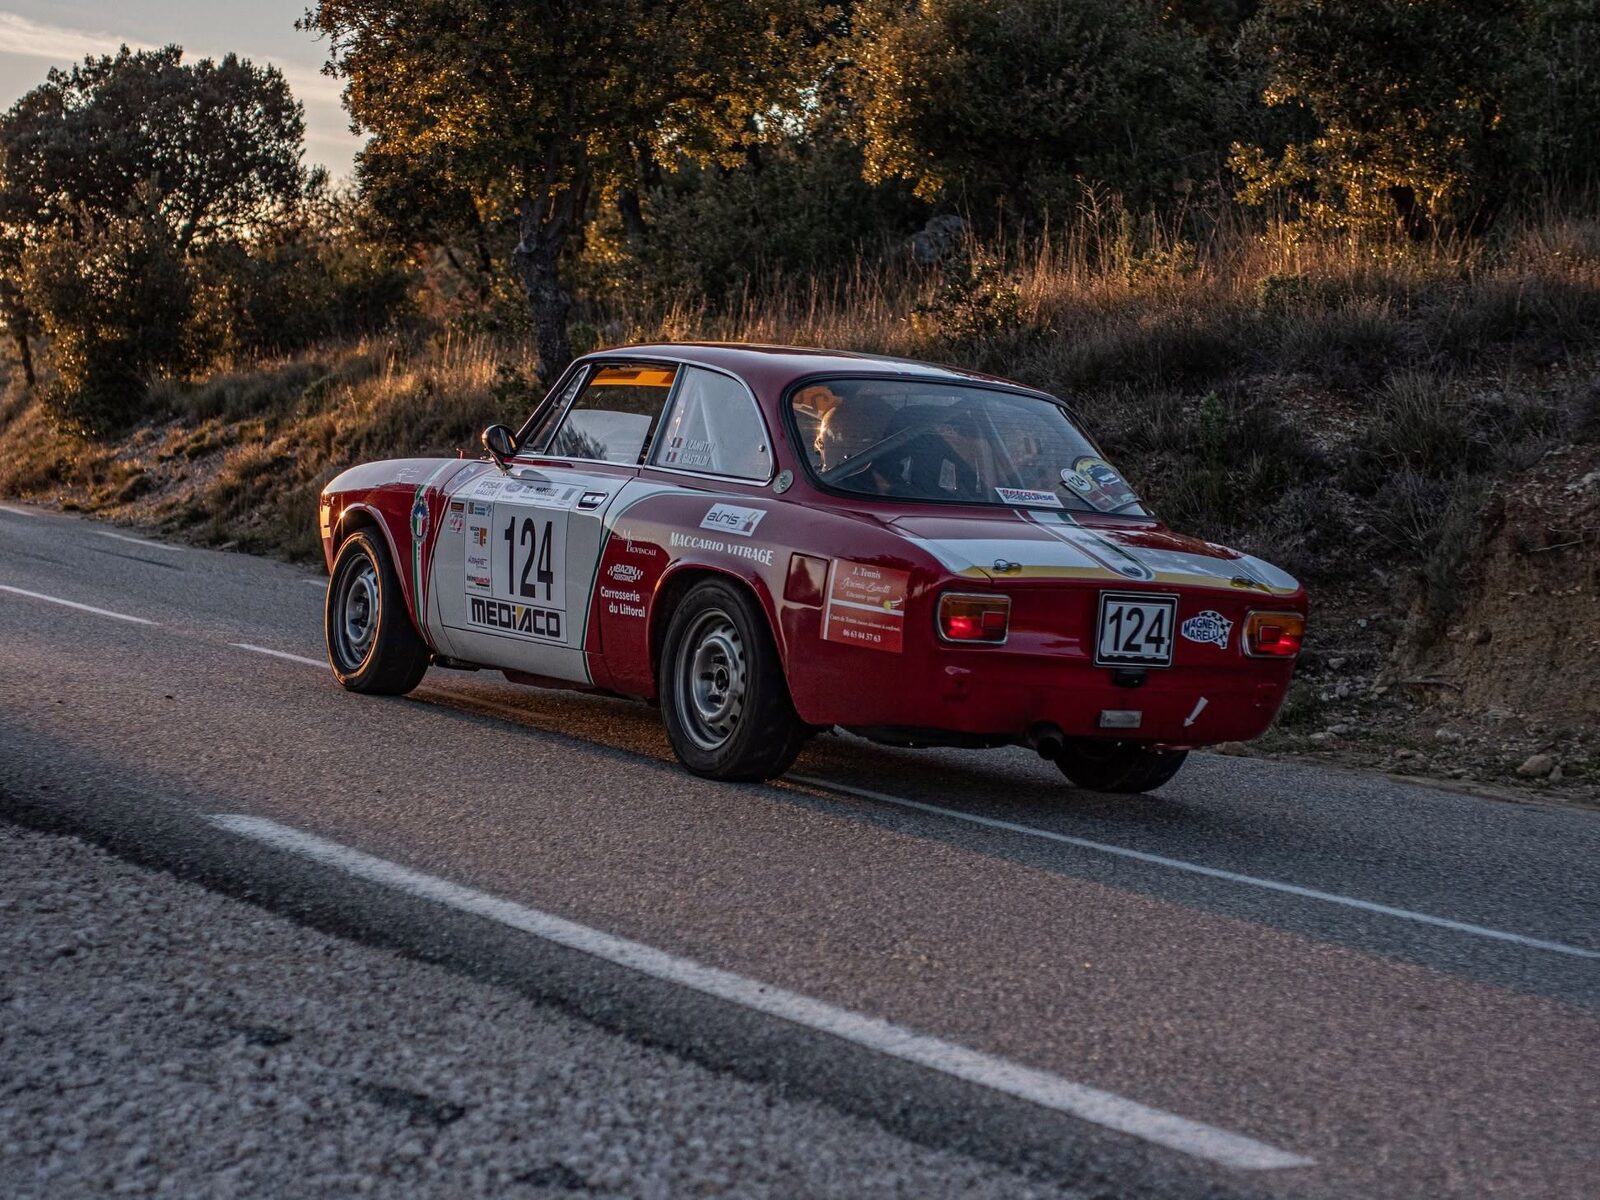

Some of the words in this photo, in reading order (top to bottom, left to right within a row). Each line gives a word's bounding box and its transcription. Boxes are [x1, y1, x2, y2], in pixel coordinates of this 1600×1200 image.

[504, 516, 553, 601] 124
[670, 532, 724, 551] MACCARIO
[727, 543, 774, 567] VITRAGE
[614, 563, 637, 576] BAZIN
[600, 586, 640, 603] Carrosserie
[608, 601, 619, 613] du
[620, 602, 646, 618] Littoral
[1108, 605, 1165, 654] 124
